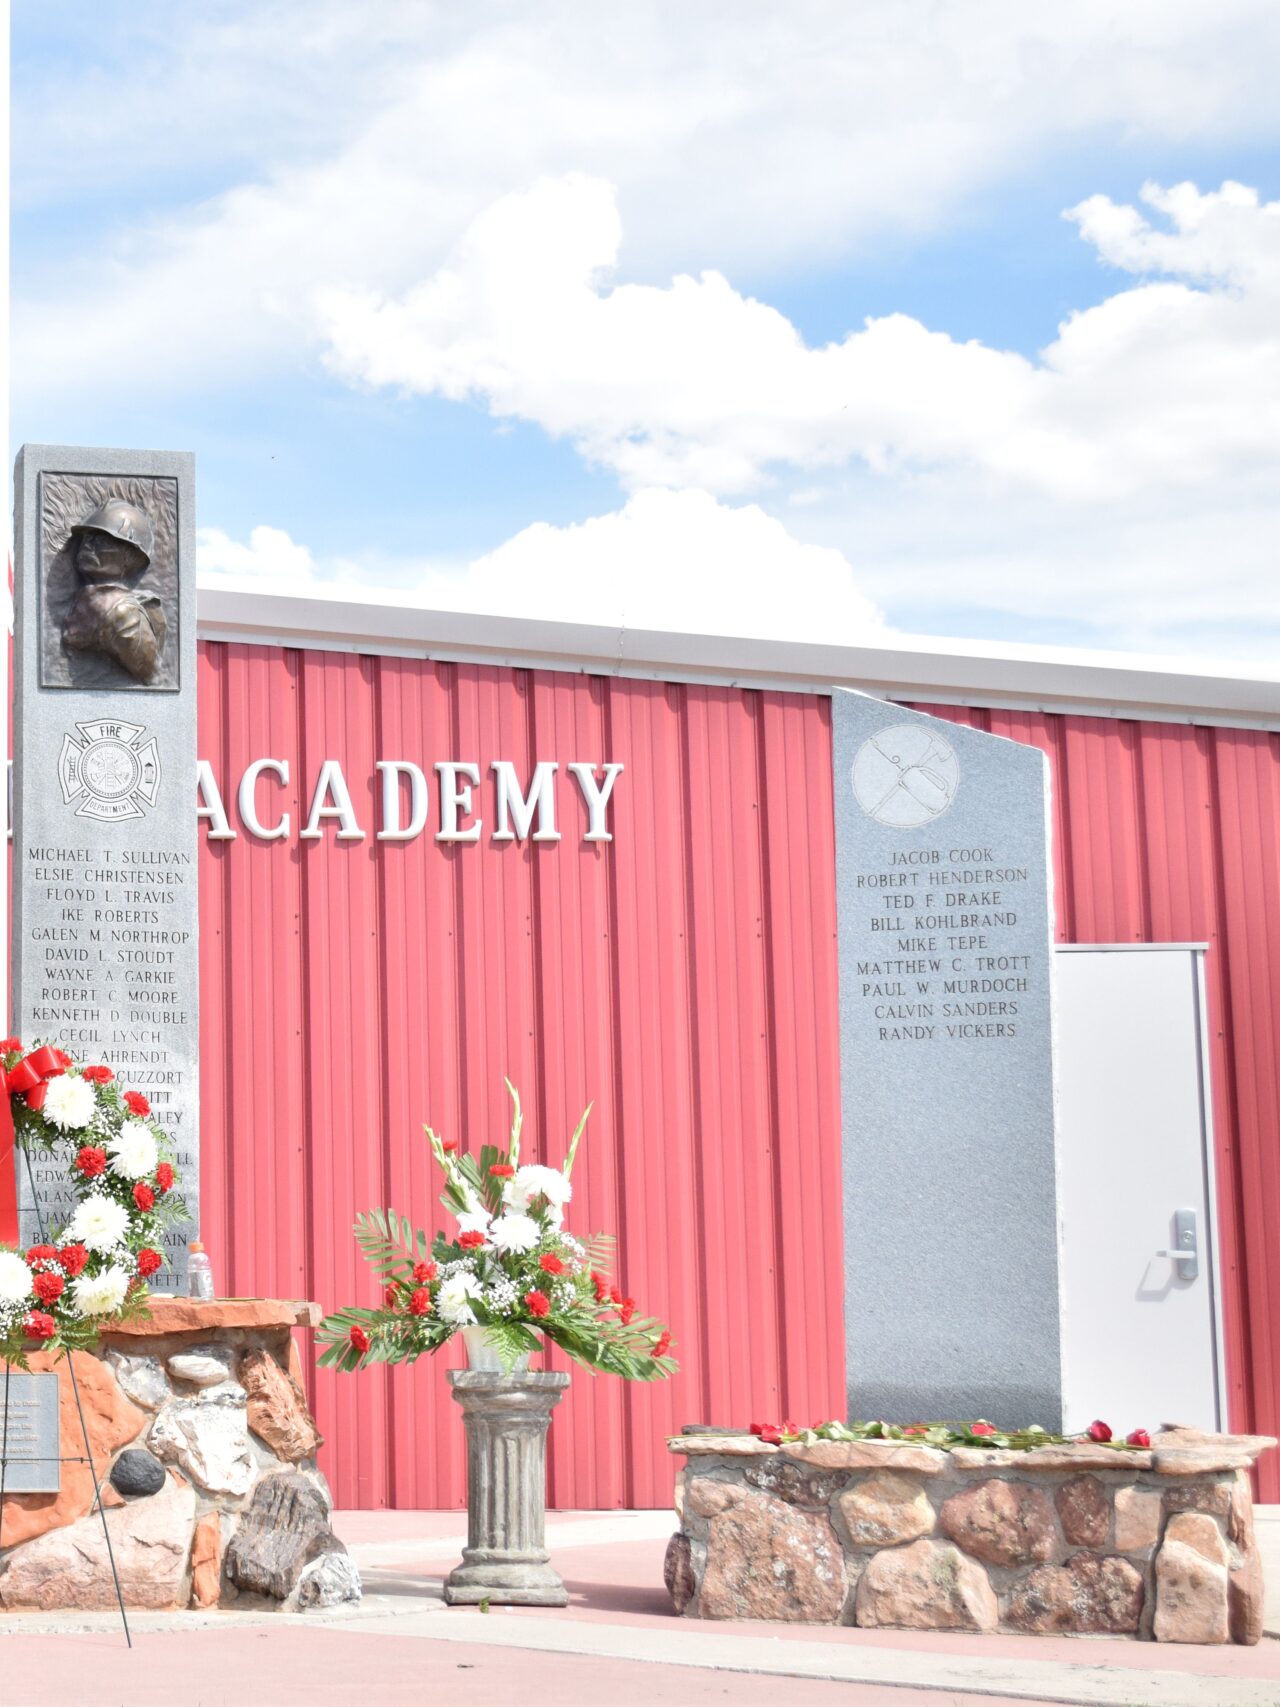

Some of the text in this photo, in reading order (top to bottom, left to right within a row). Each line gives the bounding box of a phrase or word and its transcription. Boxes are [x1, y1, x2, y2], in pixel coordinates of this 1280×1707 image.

[99, 725, 122, 738] FIRE
[89, 800, 130, 813] DEPARTMENT
[197, 758, 625, 841] ACADEMY
[29, 848, 93, 861] MICHAEL
[122, 852, 190, 864] SULLIVAN
[888, 848, 993, 865] JACOB COOK
[36, 868, 184, 884] ELSIE CHRISTENSEN
[857, 869, 1027, 888] ROBERT HENDERSON
[47, 888, 95, 901] FLOYD
[124, 891, 174, 903] TRAVIS
[883, 895, 914, 908] TED
[946, 892, 1002, 906] DRAKE
[62, 909, 159, 923] IKE ROBERTS
[871, 913, 1017, 931] BILL KOHLBRAND
[32, 928, 78, 940] GALEN
[112, 930, 189, 944] NORTHROP
[898, 935, 987, 951] MIKE TEPE
[46, 948, 88, 961] DAVID
[117, 950, 174, 963] STOUDT
[857, 960, 941, 975] MATTHEW
[976, 956, 1031, 971] TROTT
[45, 968, 93, 980] WAYNE
[125, 971, 175, 983] GARKIE
[863, 983, 906, 996] PAUL
[944, 978, 1027, 993] MURDOCH
[42, 988, 97, 1000] ROBERT
[128, 991, 178, 1003] MOORE
[33, 1008, 100, 1021] KENNETH
[130, 1011, 188, 1024] DOUBLE
[875, 1001, 1018, 1019] CALVIN SANDERS
[60, 1029, 160, 1042] CECIL LYNCH
[879, 1023, 1016, 1040] RANDY VICKERS
[100, 1051, 170, 1063] AHRENDT
[116, 1071, 184, 1084] CUZZORT
[146, 1112, 183, 1124] ALEY
[28, 1150, 73, 1162] DONA
